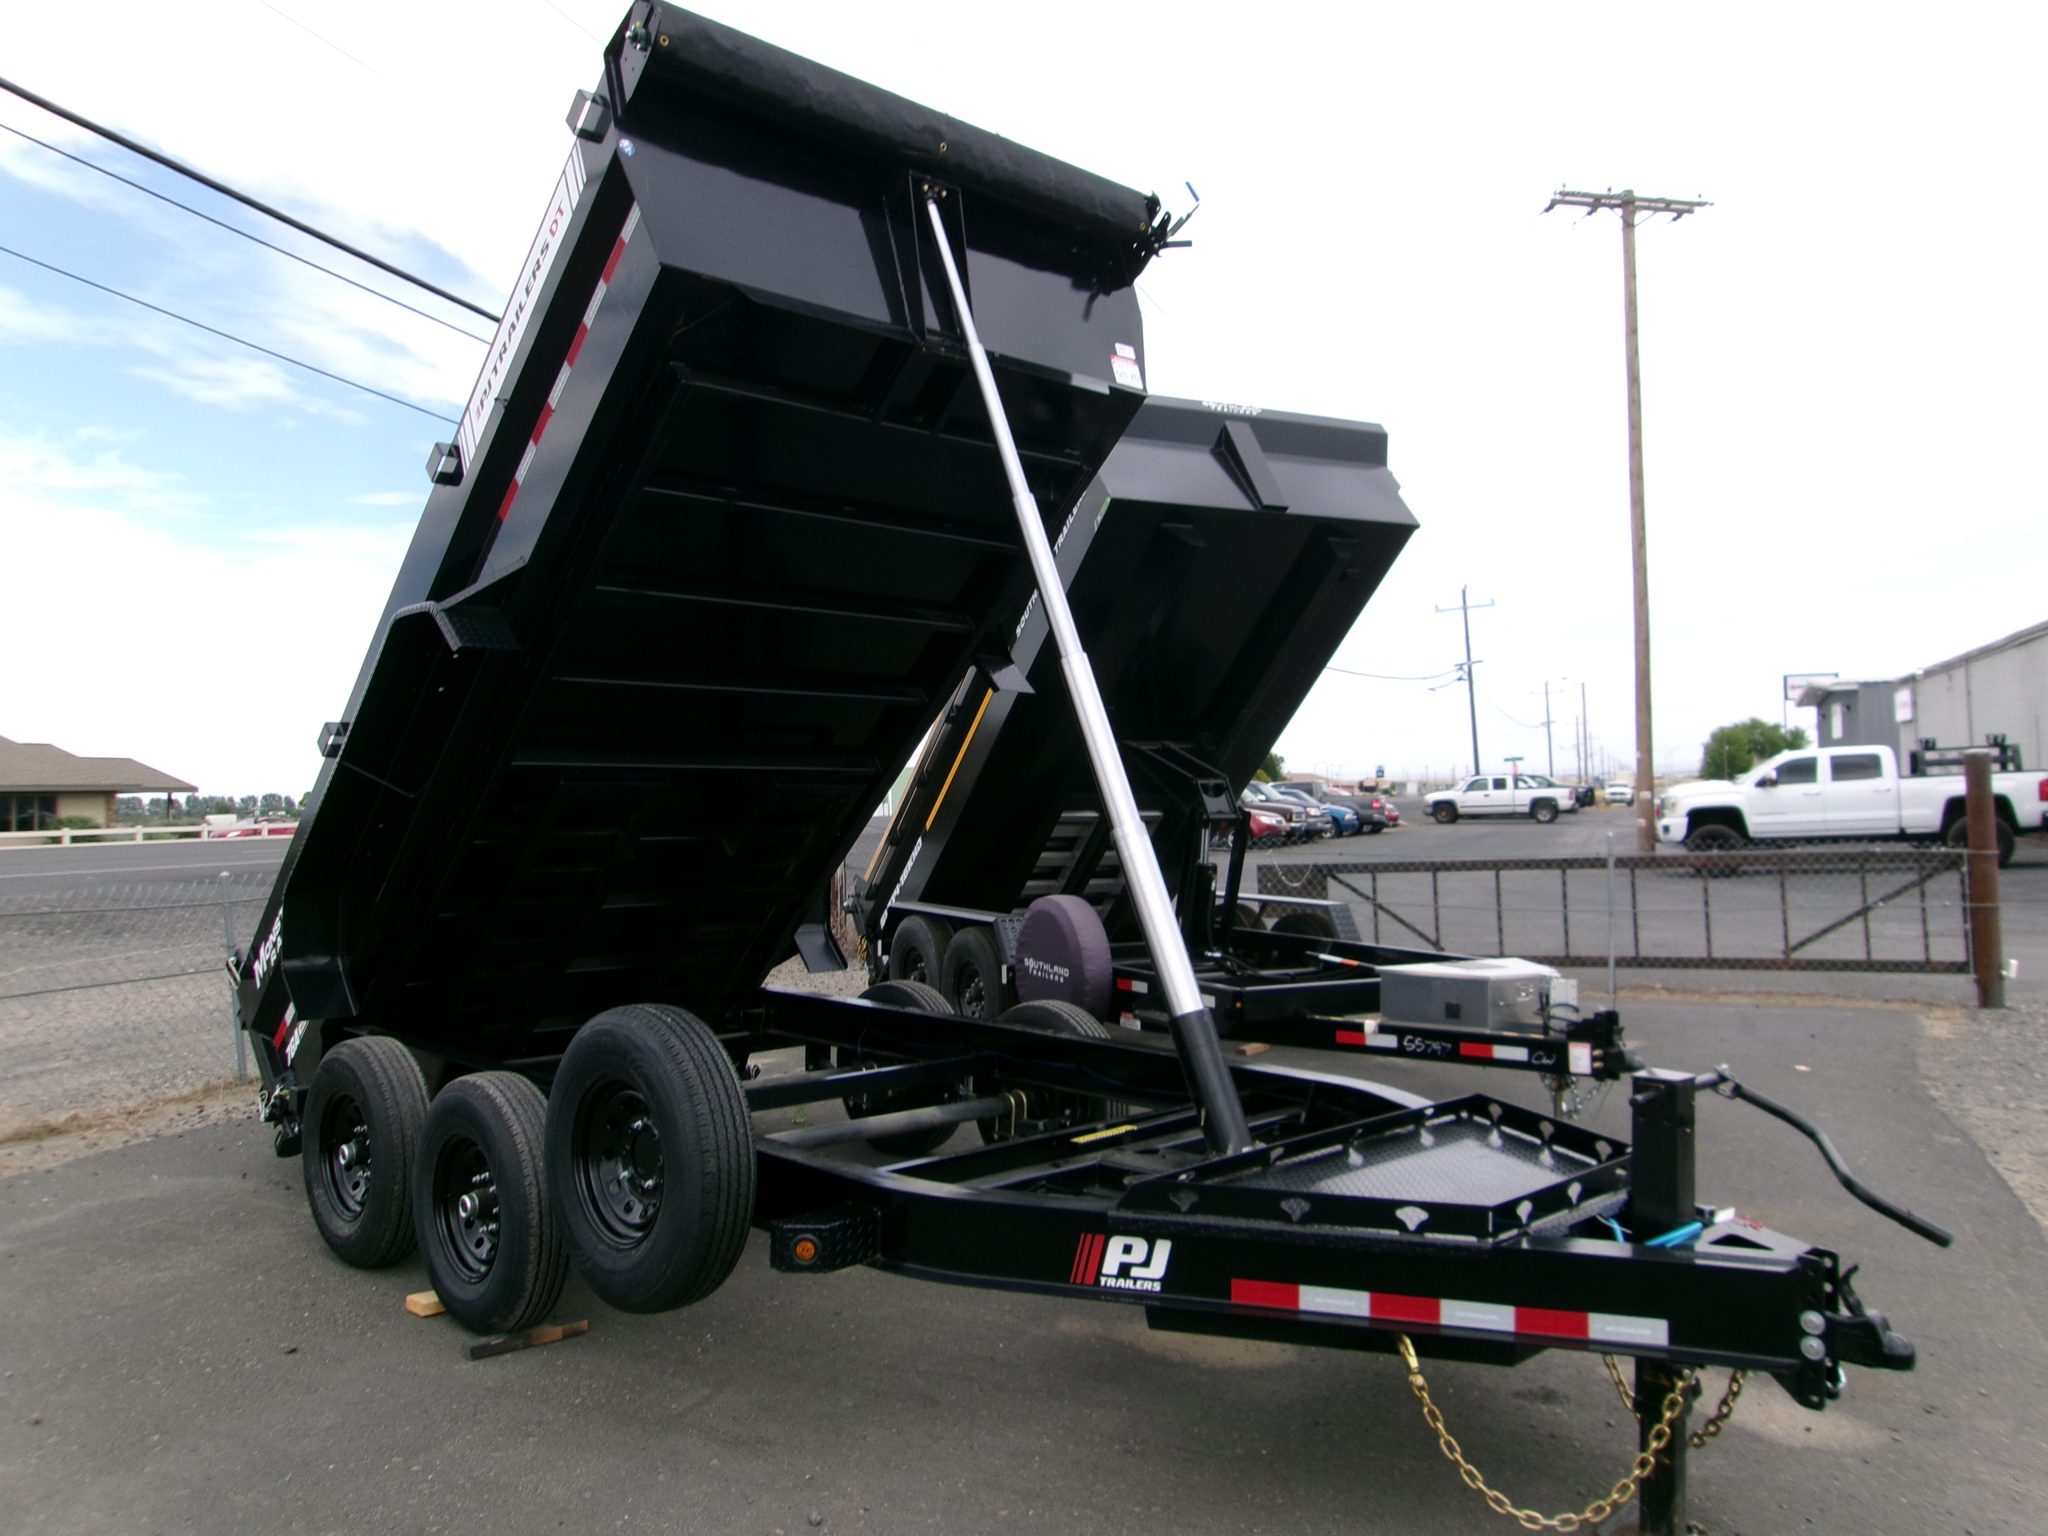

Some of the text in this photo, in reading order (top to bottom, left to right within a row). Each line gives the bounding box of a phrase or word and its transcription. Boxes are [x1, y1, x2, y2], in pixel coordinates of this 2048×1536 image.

[491, 238, 551, 378] TRAILERS
[549, 199, 565, 239] DT
[1024, 957, 1070, 978] SOUTHLAND
[1028, 964, 1064, 984] TRAILERS
[1101, 1235, 1172, 1280] PJ
[1099, 1276, 1162, 1293] TRAILERS
